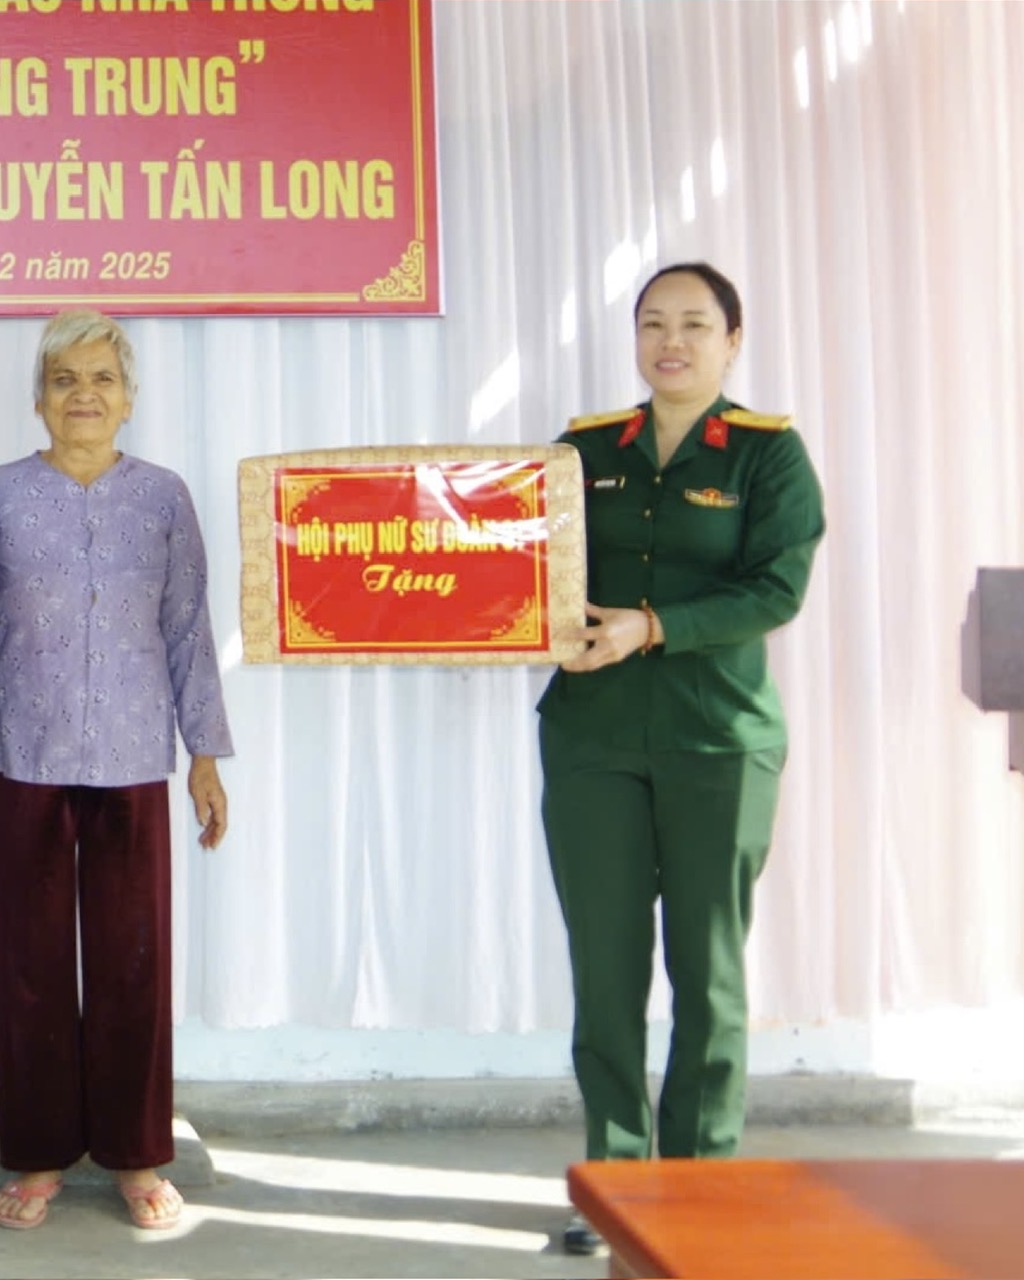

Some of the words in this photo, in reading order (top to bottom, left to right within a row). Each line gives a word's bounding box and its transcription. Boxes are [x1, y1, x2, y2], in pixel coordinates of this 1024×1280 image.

[140, 139, 242, 220] TẤN
[260, 160, 395, 220] LONG
[26, 251, 89, 281] năm
[101, 251, 172, 281] 2025
[297, 516, 330, 562] HỘI
[334, 522, 374, 561] PHỤ
[378, 515, 408, 555] NỮ
[362, 563, 458, 597] Tặng
